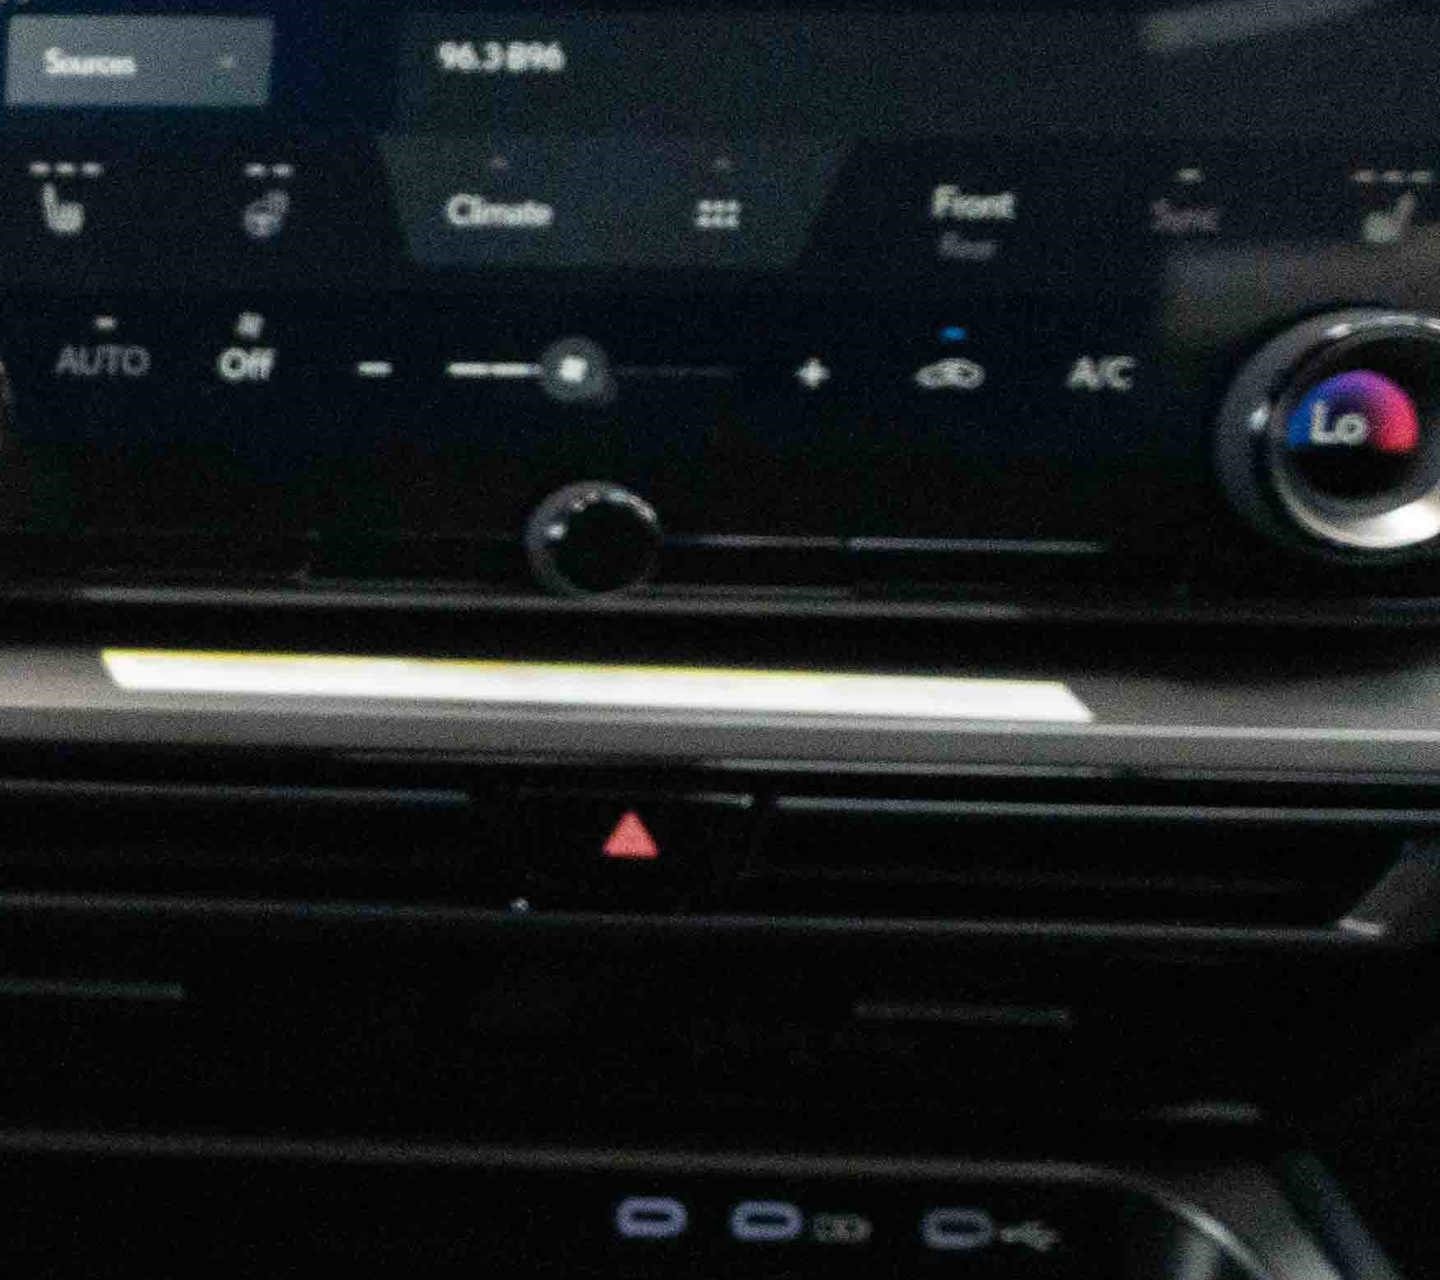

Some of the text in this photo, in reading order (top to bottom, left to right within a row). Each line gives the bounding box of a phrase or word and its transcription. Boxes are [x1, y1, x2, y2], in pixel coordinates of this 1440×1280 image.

[44, 47, 137, 77] Sources
[446, 194, 554, 228] Climate
[933, 185, 1016, 220] Front
[57, 345, 150, 377] AUTO
[218, 347, 277, 382] Off
[1067, 355, 1137, 391] A/C
